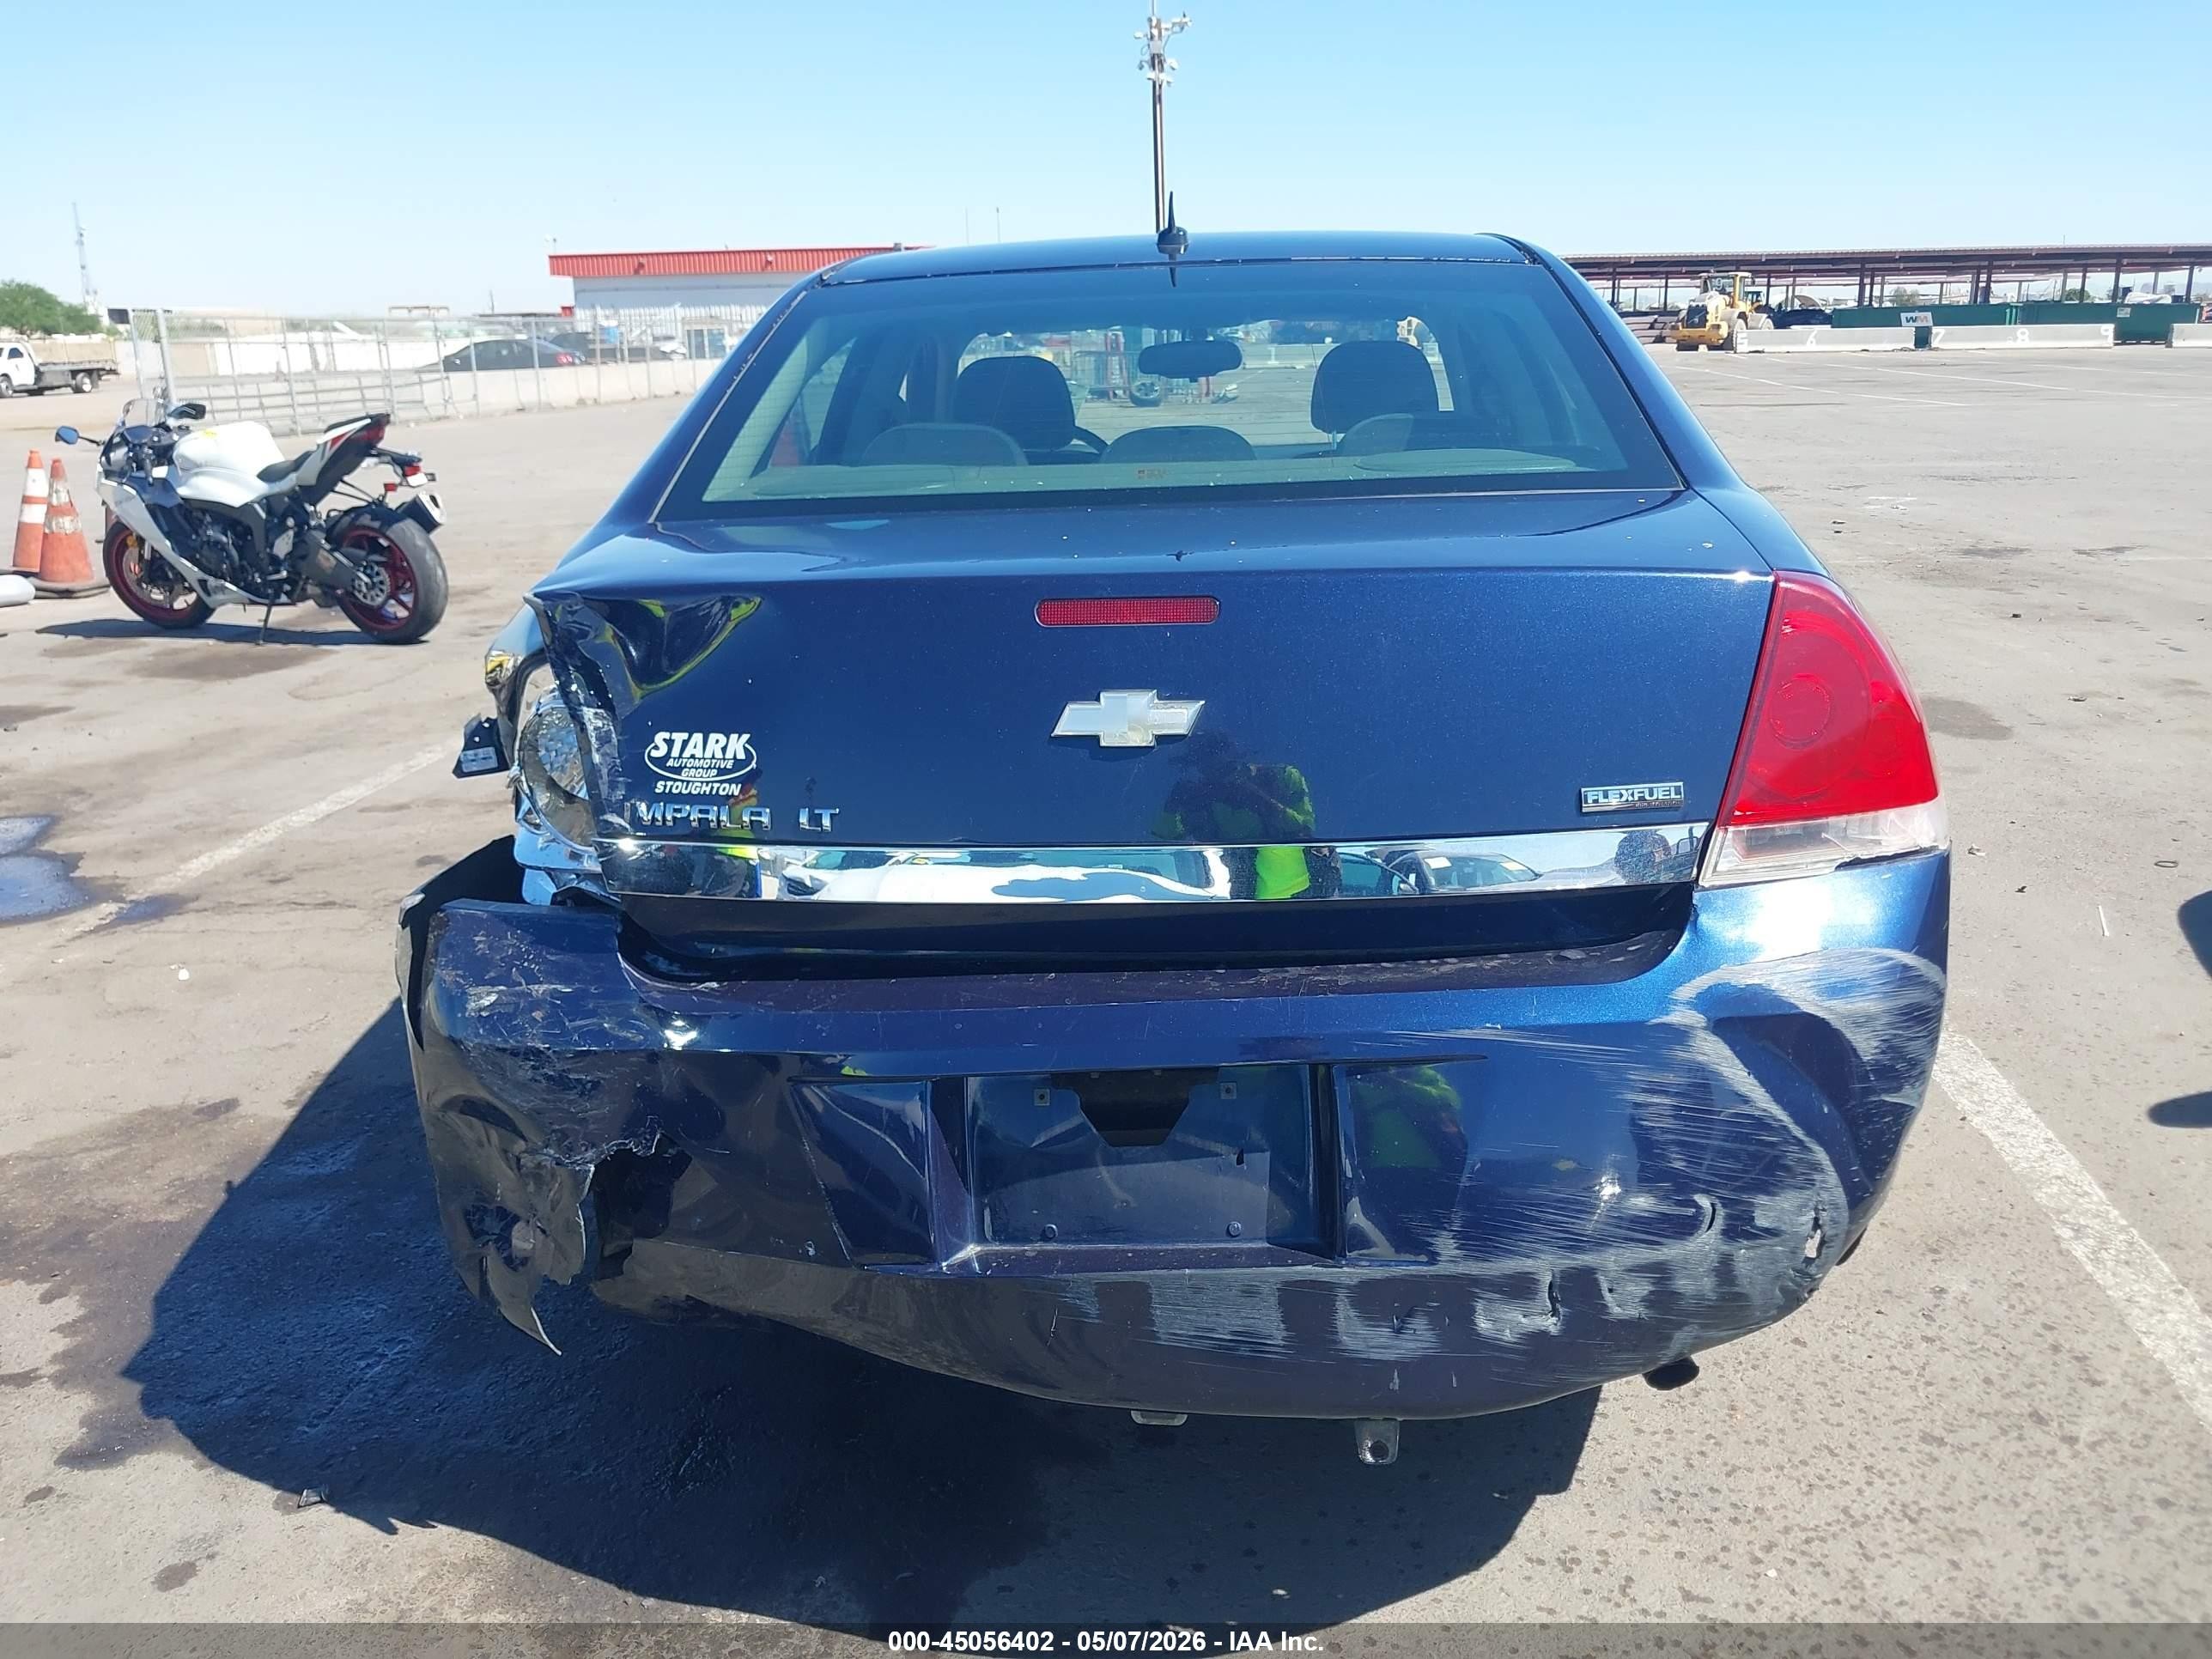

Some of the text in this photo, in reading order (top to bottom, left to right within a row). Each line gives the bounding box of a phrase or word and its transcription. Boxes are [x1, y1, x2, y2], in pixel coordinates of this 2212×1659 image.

[1806, 329, 1818, 347] 6
[1932, 328, 1946, 345] 7
[2017, 327, 2030, 344] 8
[2100, 325, 2114, 343] 9
[650, 732, 750, 759] STARK
[665, 758, 734, 769] AUTOMOTIVE
[681, 769, 717, 777] GROUP
[654, 781, 742, 796] STOUGHTON
[799, 808, 840, 832] LT
